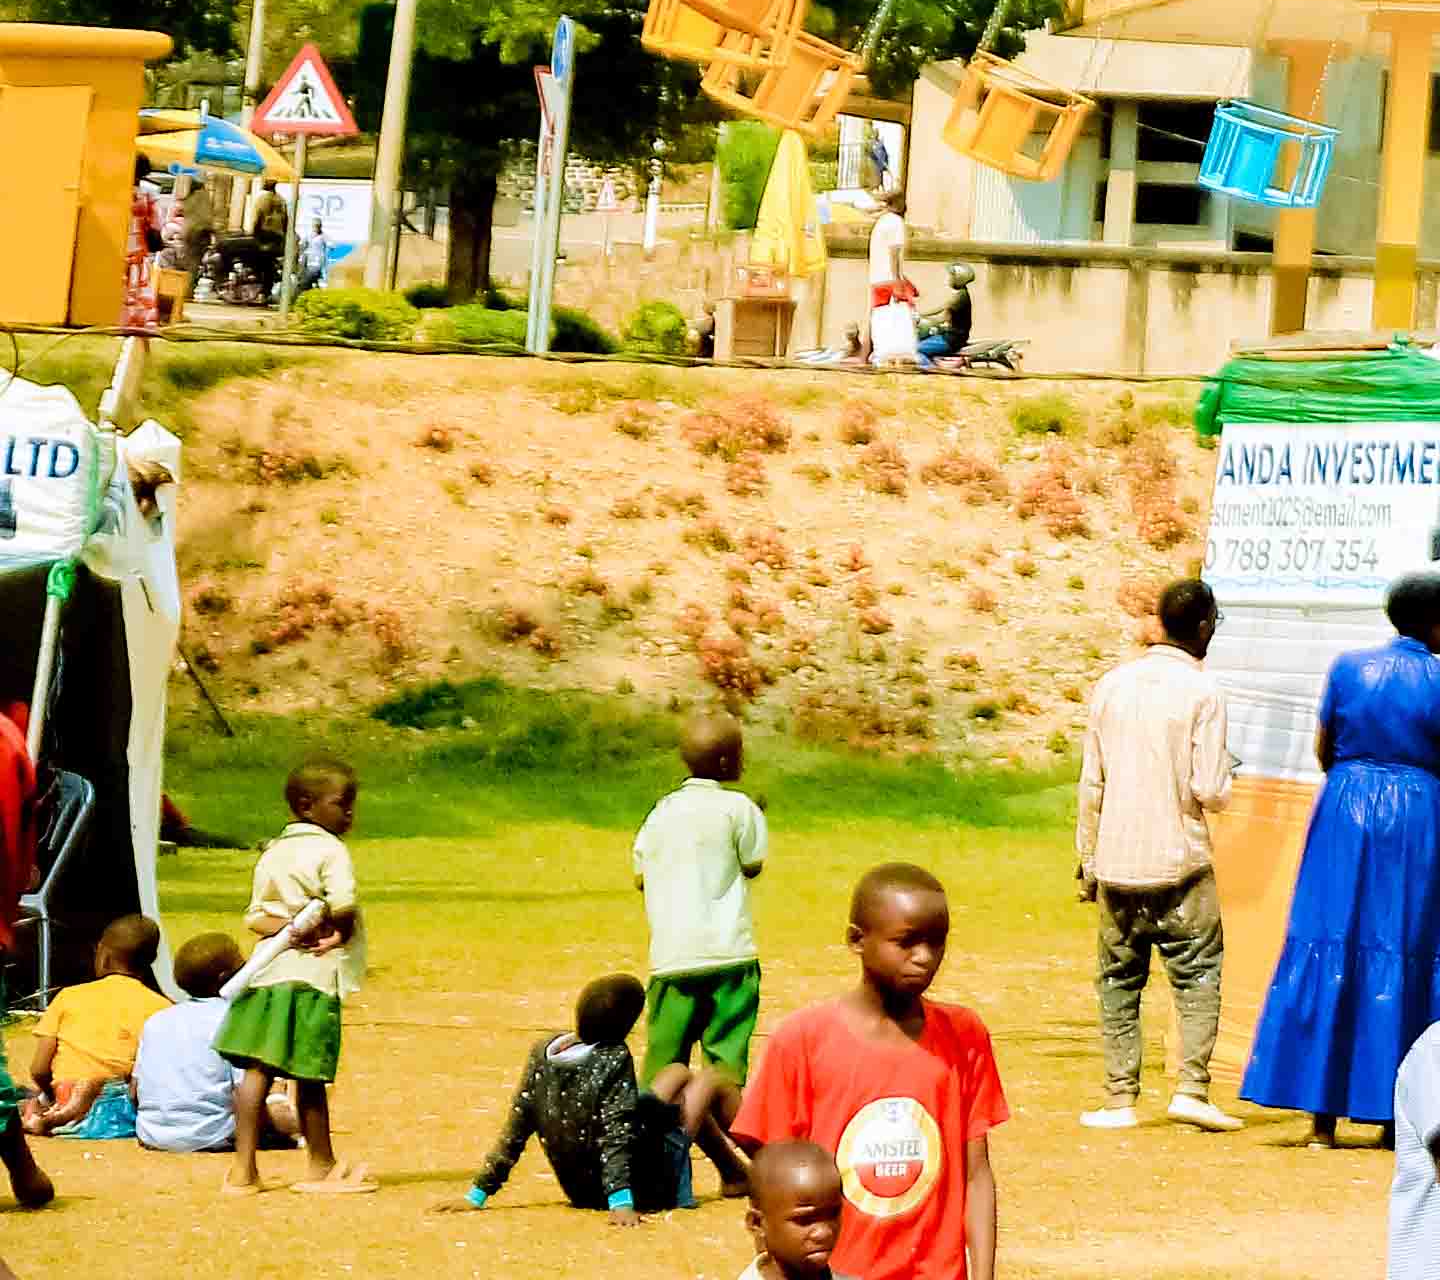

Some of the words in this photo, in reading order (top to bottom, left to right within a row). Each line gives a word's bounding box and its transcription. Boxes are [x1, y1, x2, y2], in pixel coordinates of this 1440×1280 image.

[4, 435, 80, 479] LTD
[1218, 442, 1293, 485] ANDA
[1225, 538, 1272, 571] 788
[1278, 538, 1325, 571] 307
[1331, 538, 1379, 571] 354
